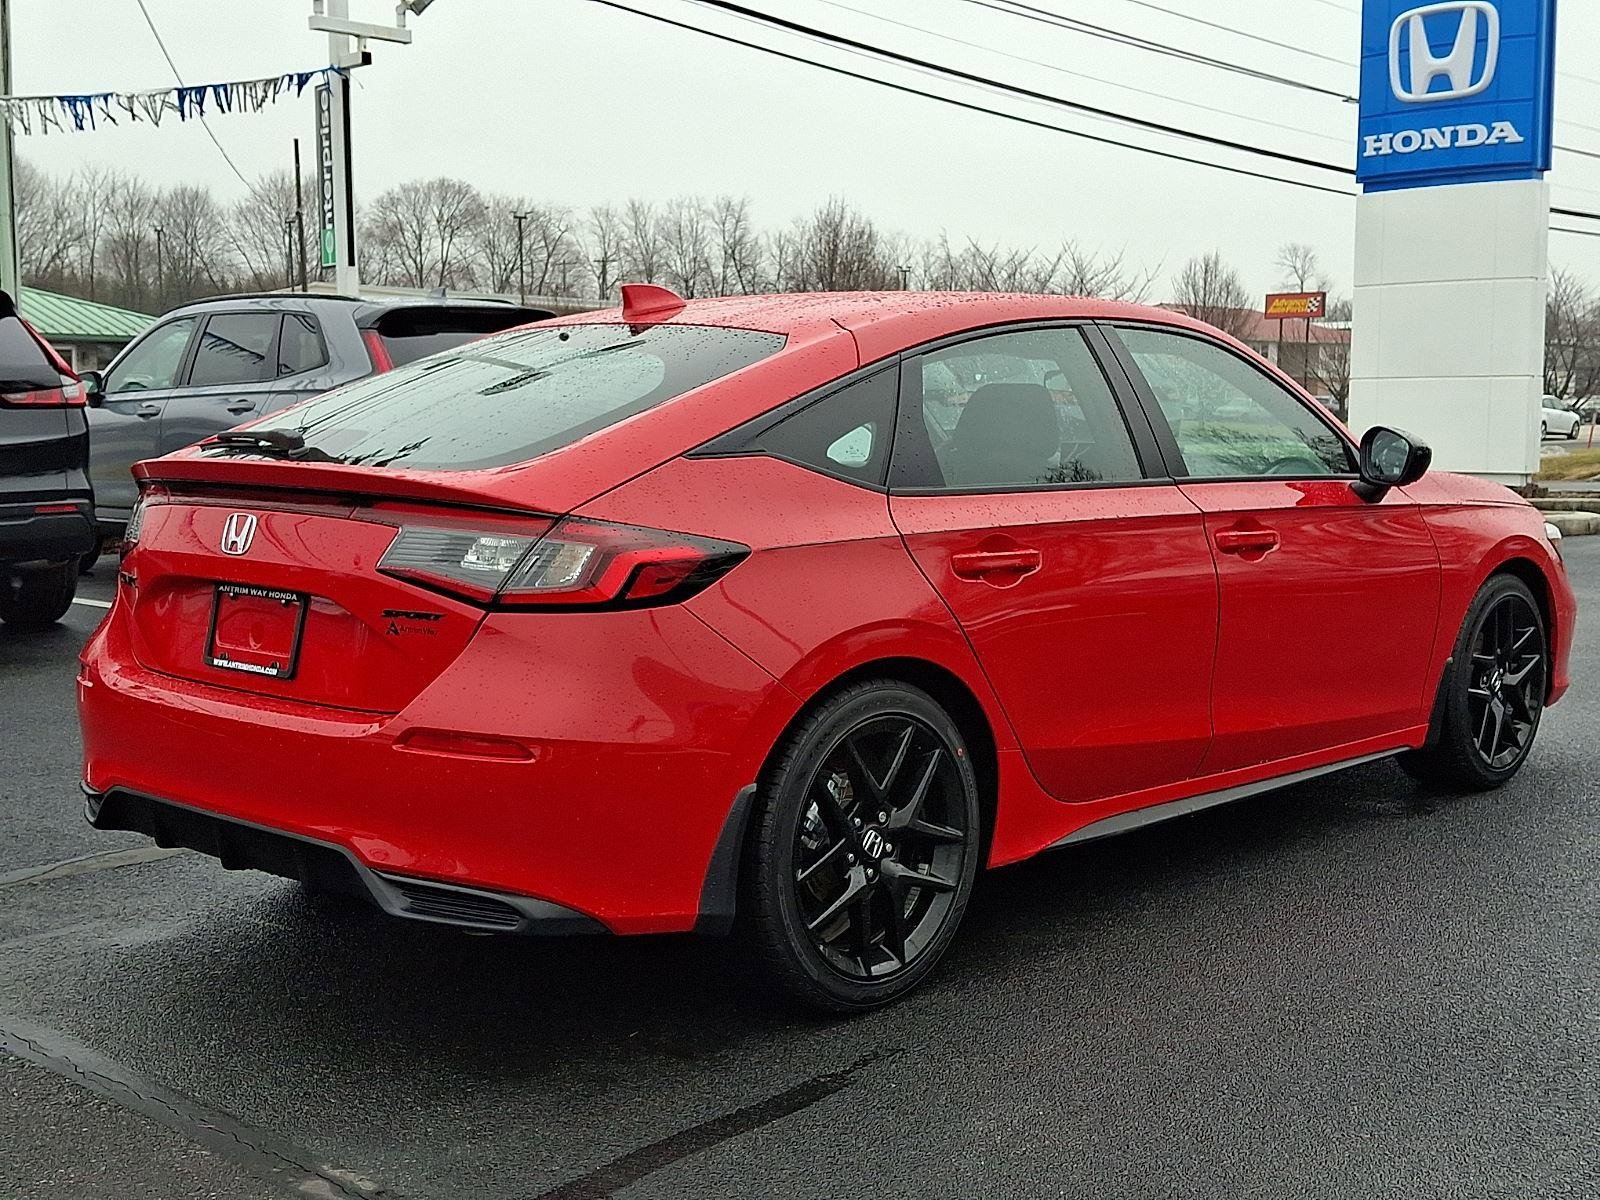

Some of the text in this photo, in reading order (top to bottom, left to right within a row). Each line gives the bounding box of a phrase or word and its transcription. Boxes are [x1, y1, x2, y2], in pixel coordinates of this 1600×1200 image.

[1363, 121, 1524, 157] HONDA
[218, 585, 297, 600] ANTRIM WAY HONDA
[381, 609, 447, 620] SPORT
